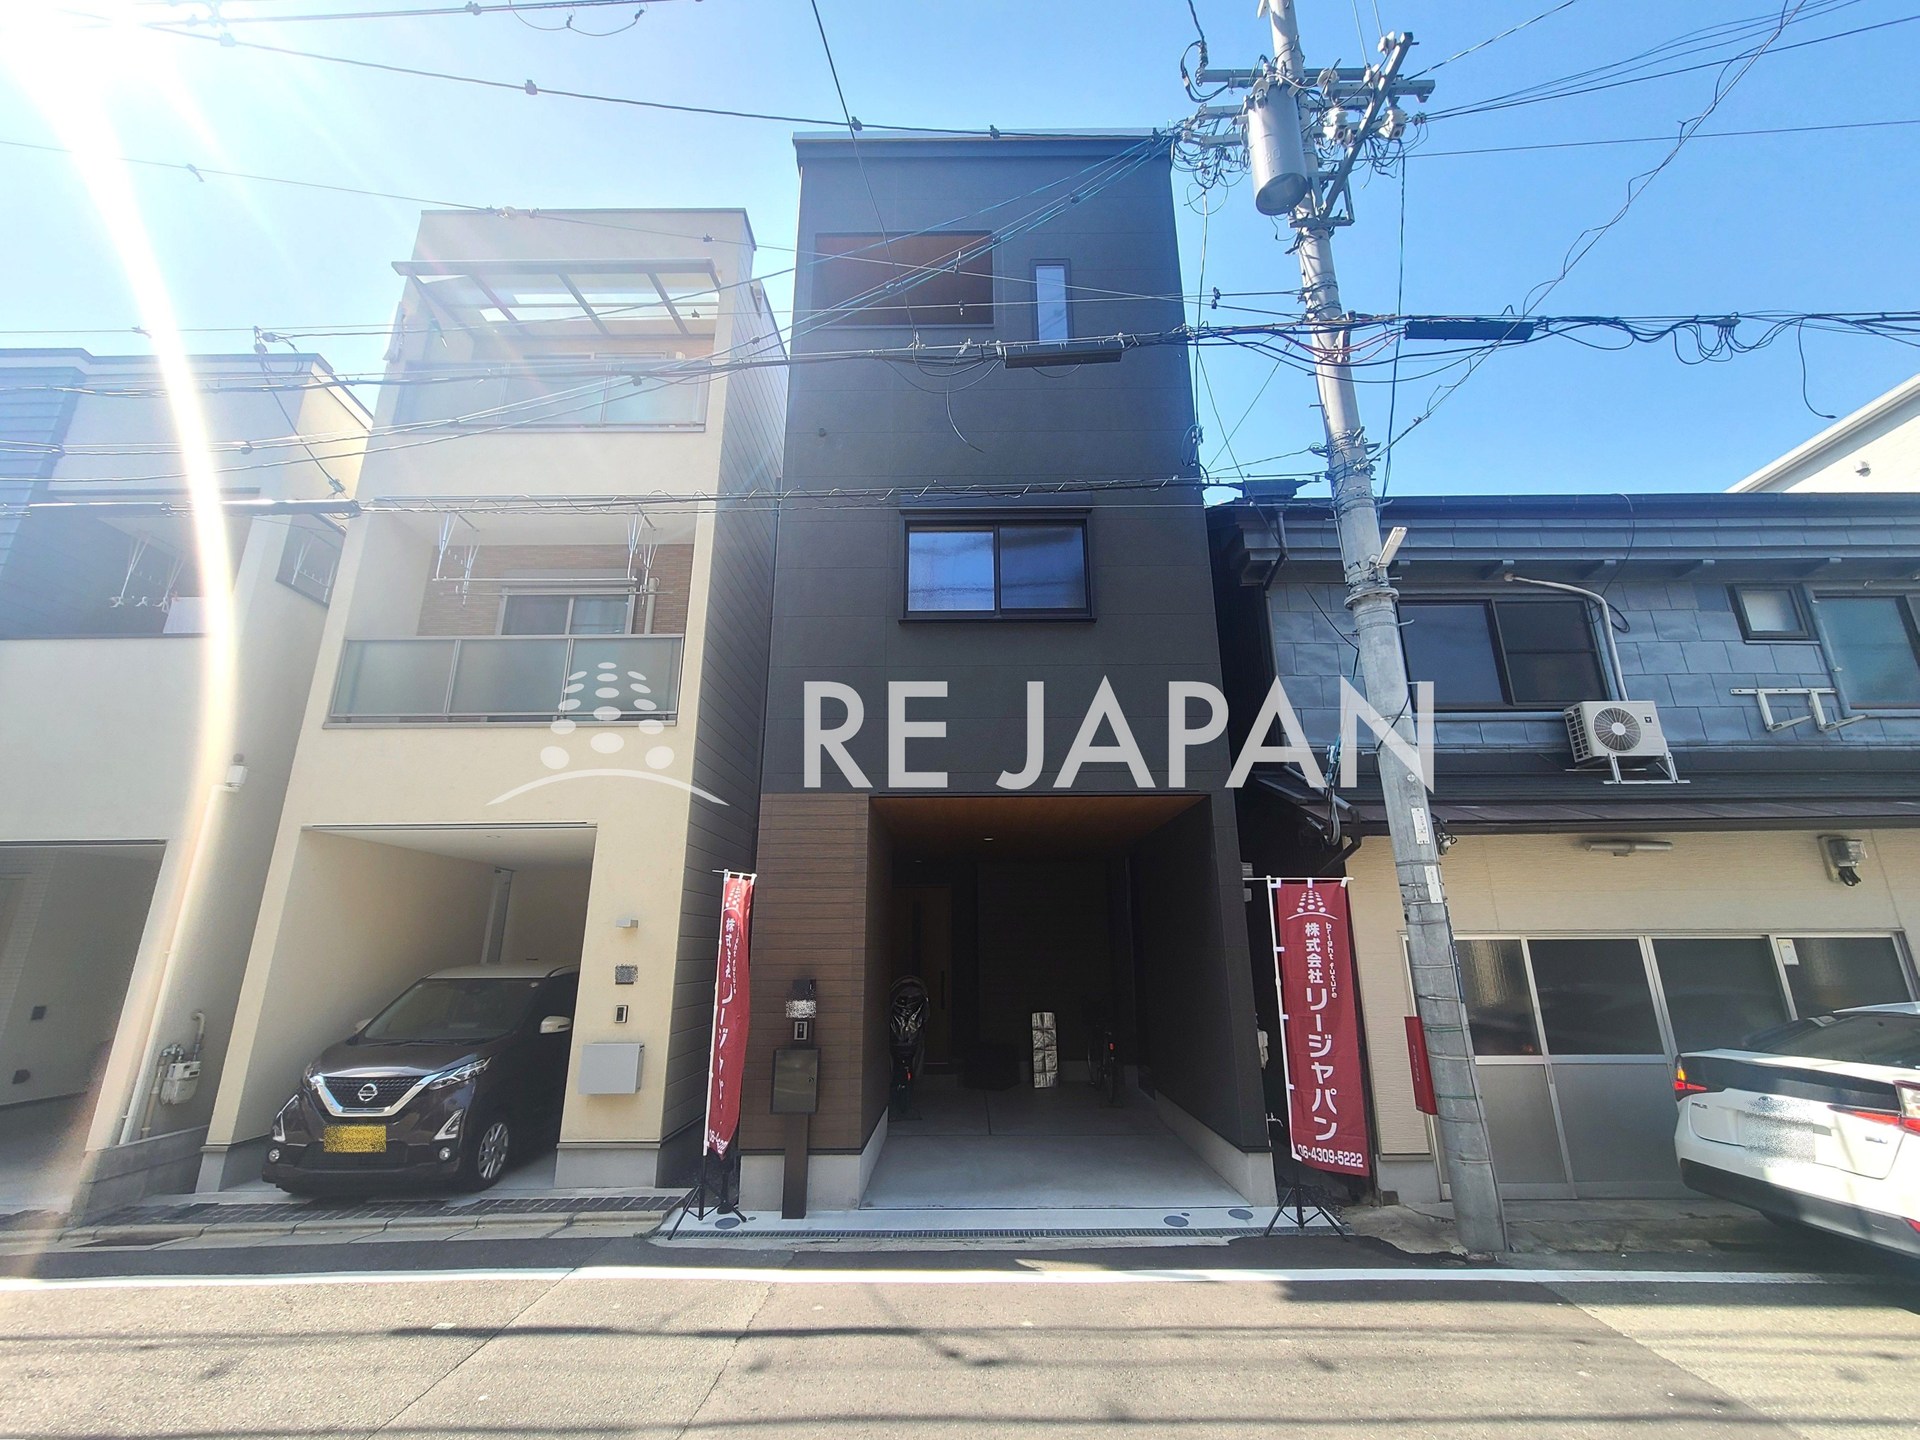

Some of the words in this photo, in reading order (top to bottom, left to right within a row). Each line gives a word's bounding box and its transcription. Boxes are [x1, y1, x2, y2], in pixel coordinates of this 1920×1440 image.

[1325, 921, 1334, 960] bright
[1329, 962, 1338, 998] future
[1304, 922, 1338, 1141] 株式会社リージャパン
